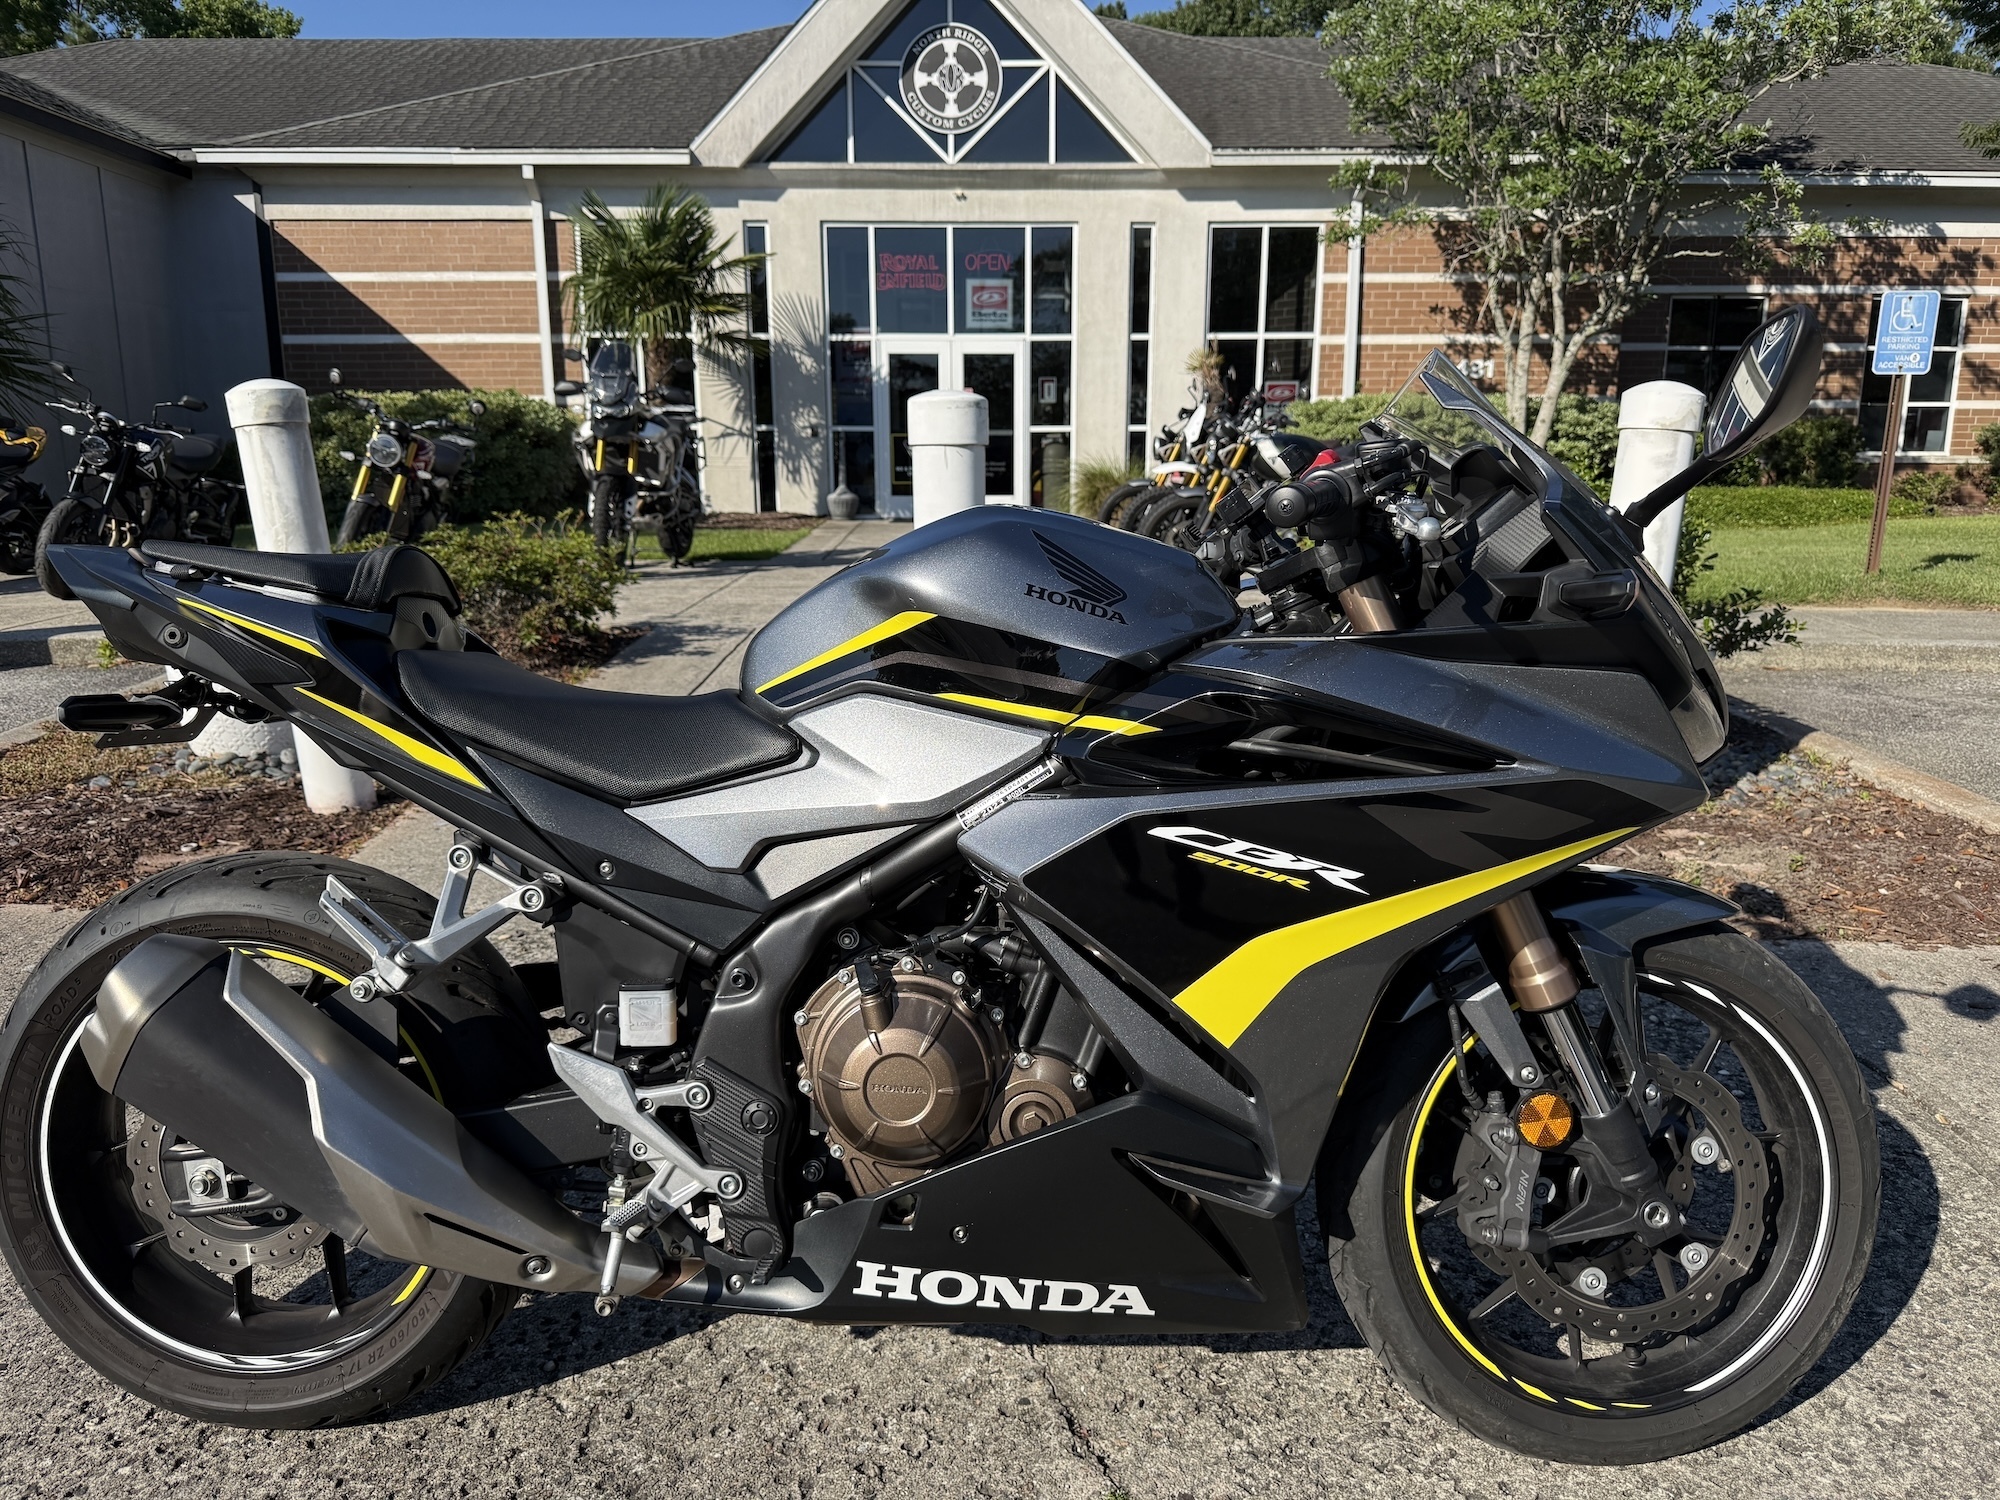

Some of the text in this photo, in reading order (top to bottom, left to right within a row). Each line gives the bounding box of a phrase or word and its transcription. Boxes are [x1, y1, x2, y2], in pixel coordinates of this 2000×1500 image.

[911, 27, 990, 56] NORTH RIDGE
[907, 89, 996, 129] CUSTOM CYCLES
[879, 253, 939, 272] ROYAL
[964, 253, 1011, 271] OPEN
[876, 272, 946, 291] ENFIELD
[1881, 335, 1929, 343] RESTRICTED
[1877, 361, 1925, 369] ACCESSIBLE
[1023, 583, 1129, 626] HONDA
[980, 798, 1006, 817] 2023
[1006, 786, 1026, 801] MODEL
[1146, 826, 1370, 896] CBR
[1187, 851, 1311, 891] 500R
[43, 986, 78, 1027] ROAD
[871, 1083, 928, 1095] HONDA
[5, 1042, 46, 1222] MICHELIN
[852, 1259, 1156, 1316] HONDA
[388, 1300, 431, 1348] 160/60
[348, 1359, 363, 1377] 17
[367, 1349, 386, 1366] ZR
